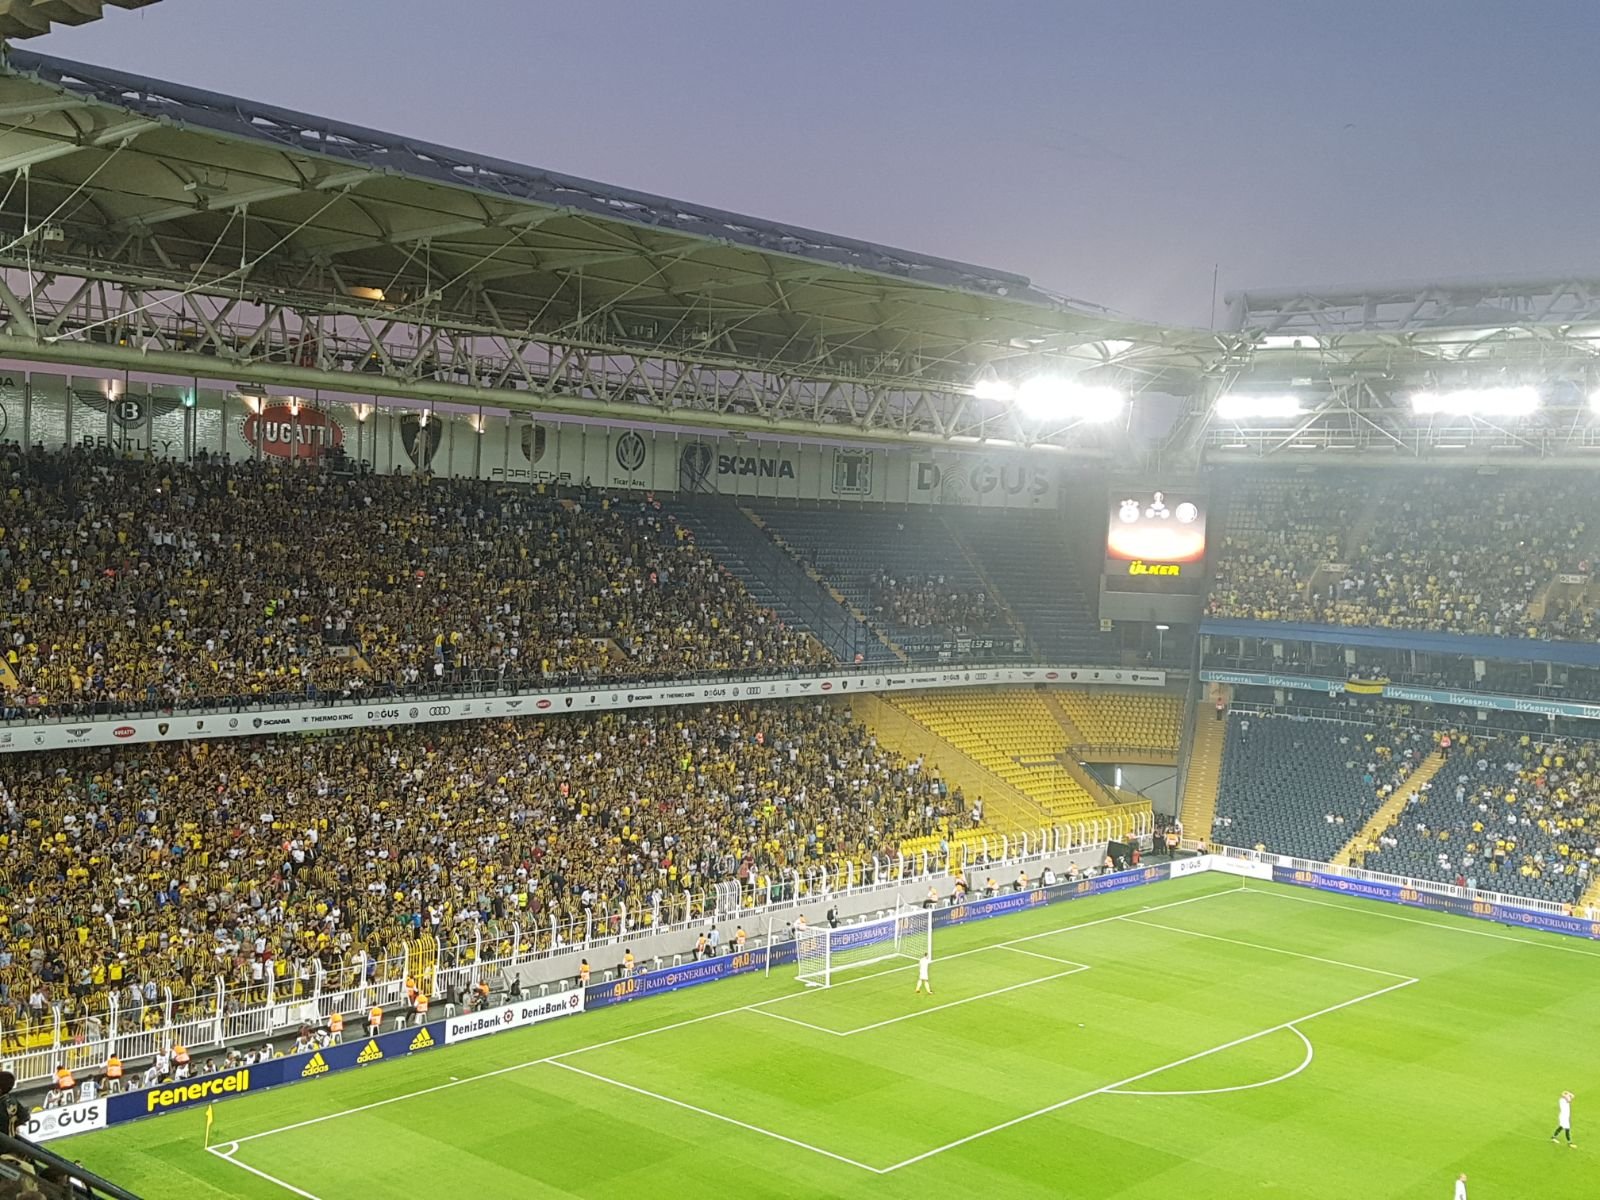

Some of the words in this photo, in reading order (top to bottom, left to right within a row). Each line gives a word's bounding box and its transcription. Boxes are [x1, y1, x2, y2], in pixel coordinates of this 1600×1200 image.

[253, 420, 334, 445] BUGATTI
[83, 434, 173, 453] BENTLEY
[491, 467, 572, 482] PORSCHE
[716, 454, 795, 480] SCANIA
[263, 718, 291, 726] SCANIA
[311, 714, 338, 723] THERMO
[338, 713, 353, 721] KING
[674, 963, 724, 982] FENERBAHÇE
[613, 978, 634, 997] 97.0
[521, 1000, 567, 1019] DenizBank
[452, 1017, 501, 1036] DenizBank
[409, 1039, 435, 1051] adidas
[357, 1051, 383, 1064] adidas
[301, 1064, 329, 1077] adidas
[147, 1069, 250, 1112] Fenercell
